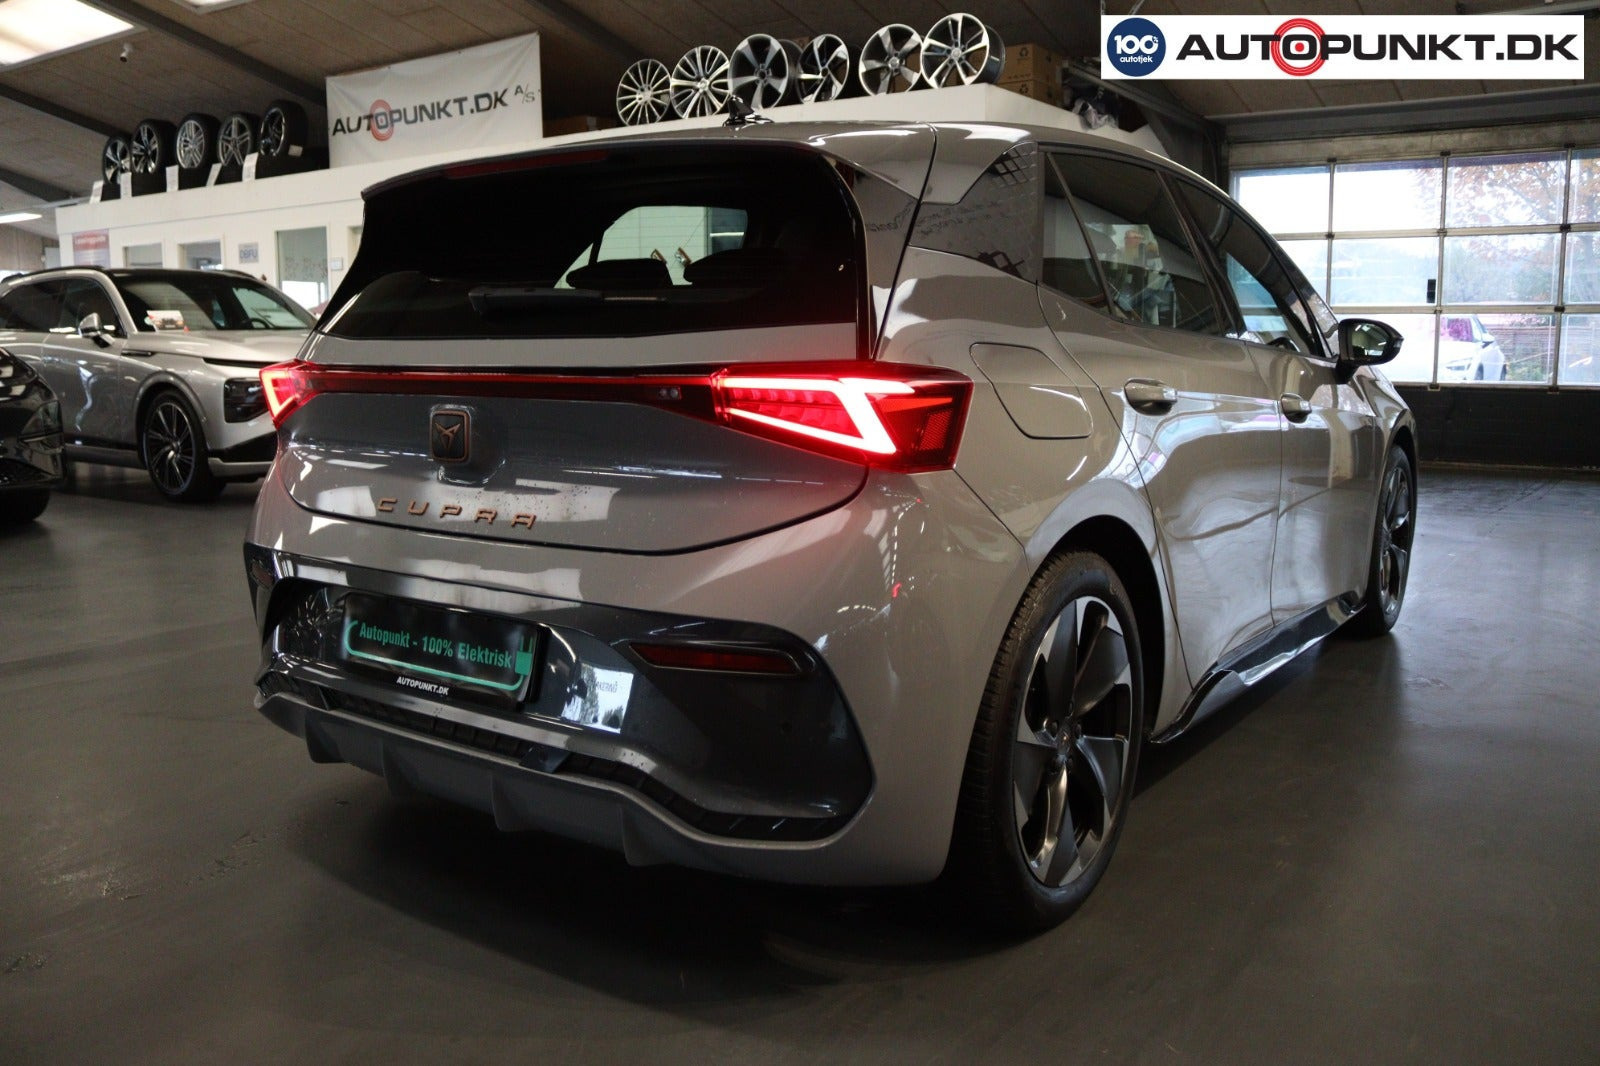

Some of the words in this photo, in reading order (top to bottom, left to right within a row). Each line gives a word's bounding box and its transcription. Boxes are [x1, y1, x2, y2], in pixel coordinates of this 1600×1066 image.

[332, 88, 508, 136] AUTOPUNKT.DK
[514, 84, 536, 104] A/S
[377, 497, 537, 530] CUPRA
[359, 621, 410, 648] Autopunkt
[422, 635, 454, 658] 100%
[457, 642, 512, 669] Elektrisk
[396, 675, 449, 696] AUTOPUNKT.DK
